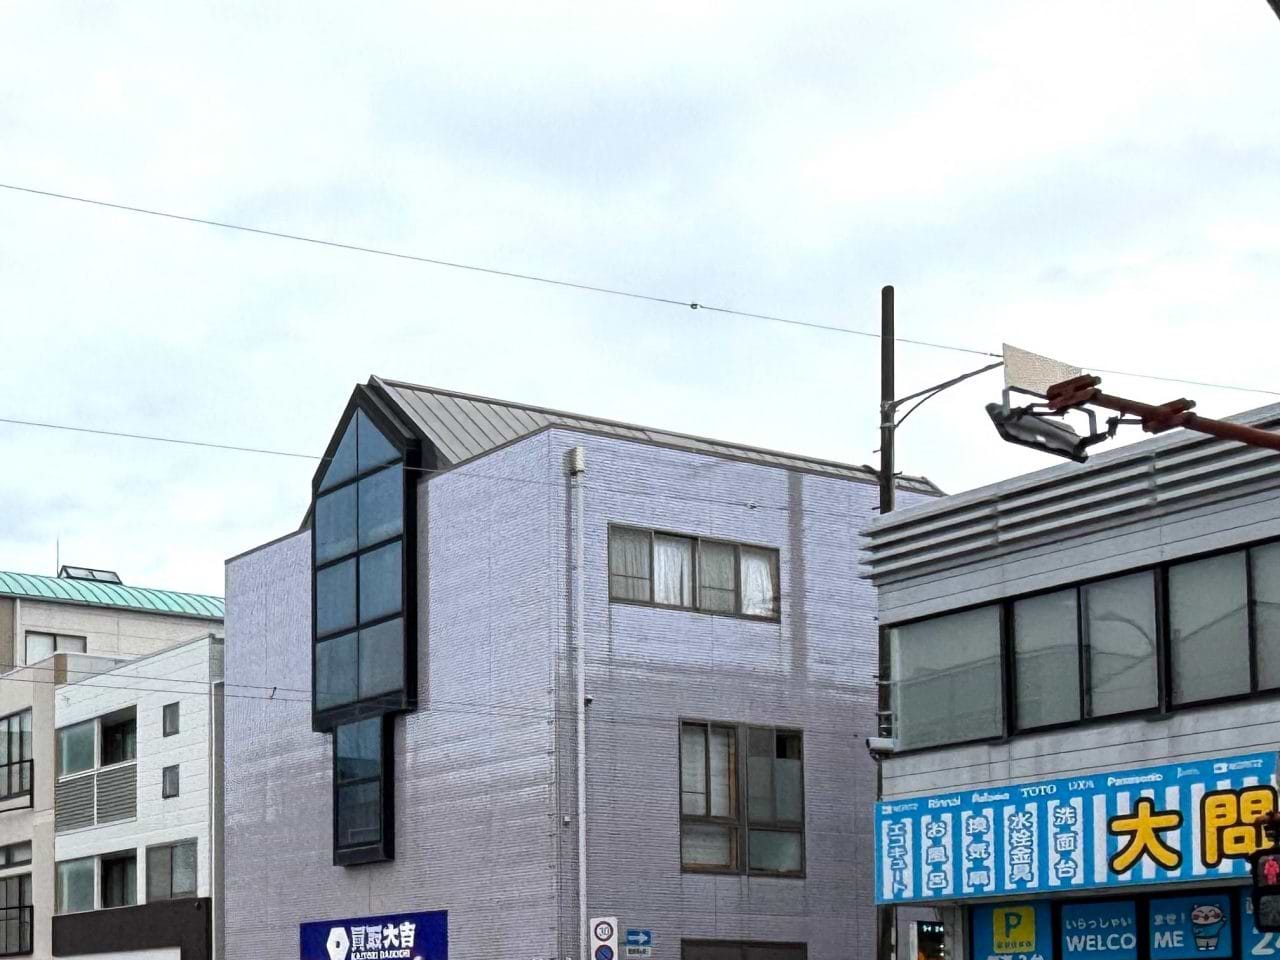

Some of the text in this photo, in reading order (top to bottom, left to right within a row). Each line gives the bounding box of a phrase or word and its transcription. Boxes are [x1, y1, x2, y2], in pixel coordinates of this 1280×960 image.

[928, 796, 961, 808] Rinnai
[1021, 784, 1057, 798] TOTO
[1107, 773, 1163, 787] Panasonic
[926, 820, 948, 890] お風呂
[1008, 811, 1034, 884] 水栓金具
[1053, 805, 1078, 880] 洗面台
[351, 921, 416, 951] 買取大吉
[1005, 912, 1022, 938] P
[1065, 918, 1132, 930] いらっしゃい
[1066, 931, 1185, 952] WELCO ME
